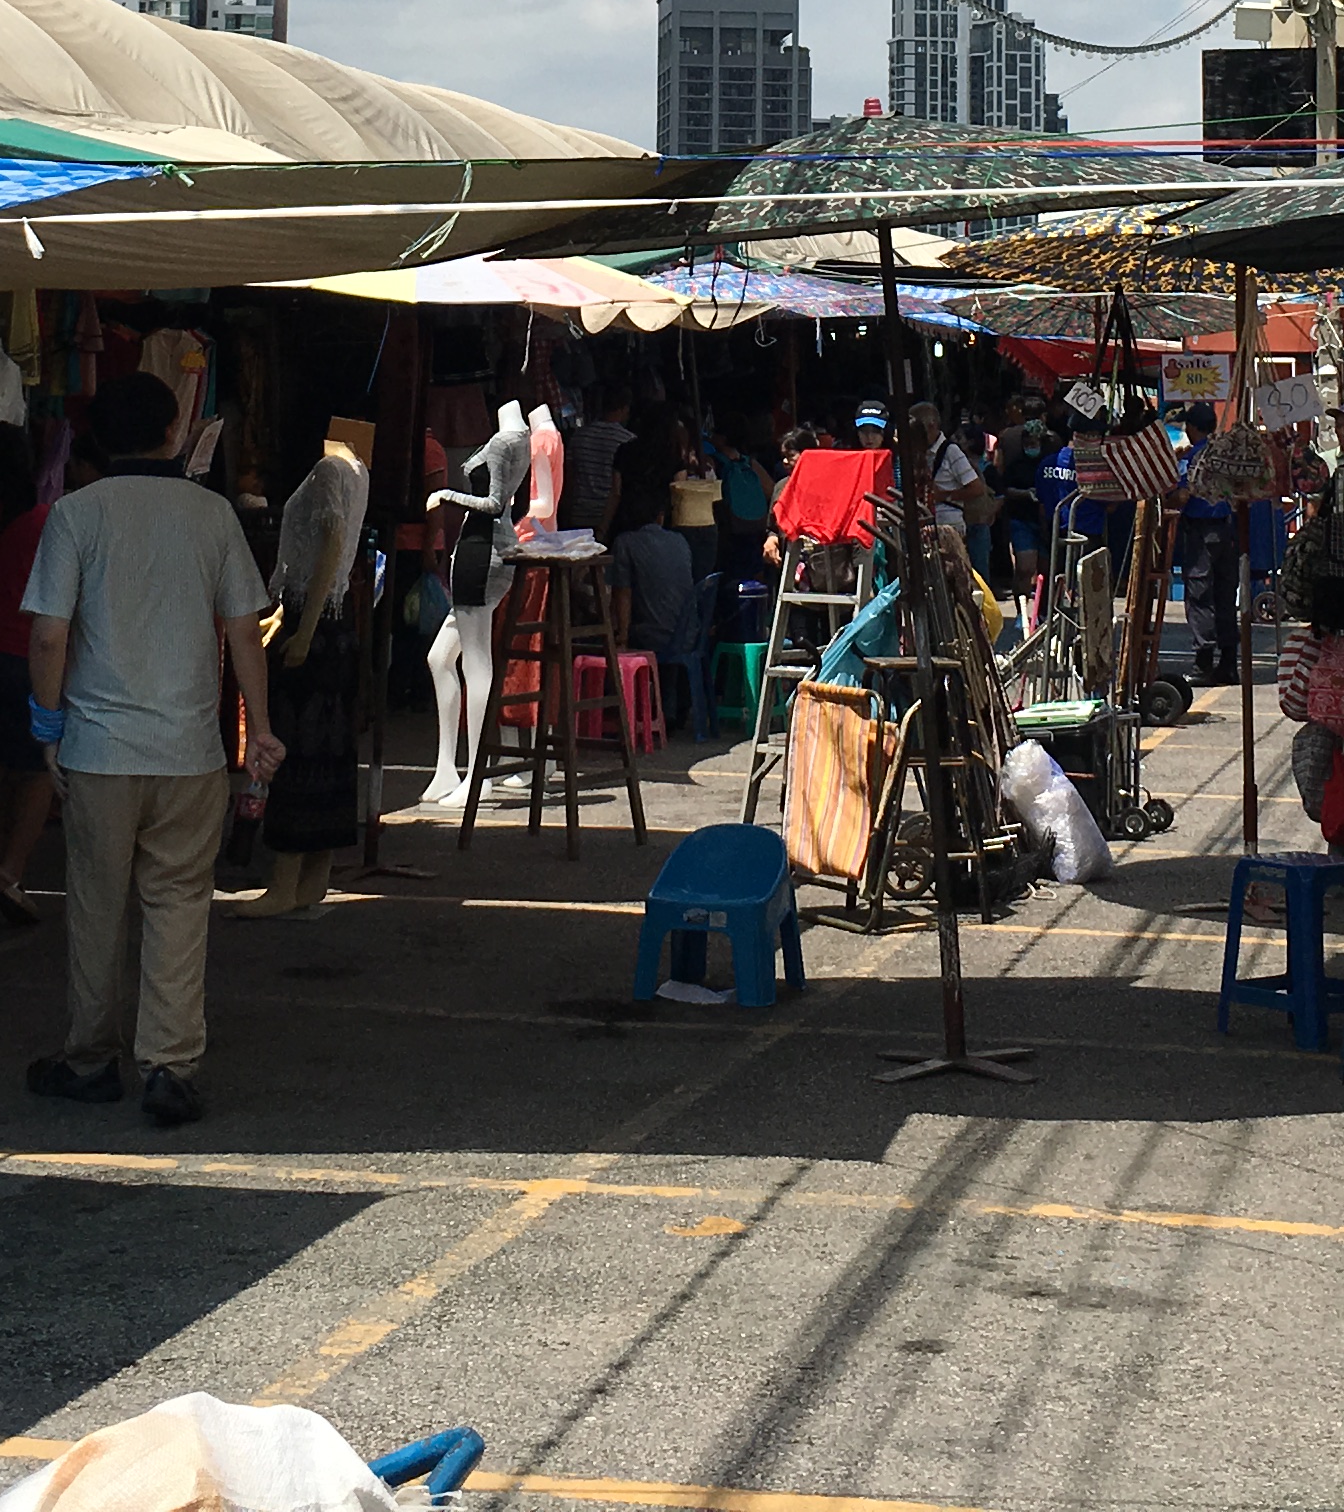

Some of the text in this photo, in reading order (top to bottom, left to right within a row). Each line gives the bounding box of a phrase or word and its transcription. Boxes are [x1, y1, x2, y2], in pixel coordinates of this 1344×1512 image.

[1071, 387, 1097, 413] 100
[1267, 383, 1308, 418] 80
[1043, 466, 1077, 482] SECURI
